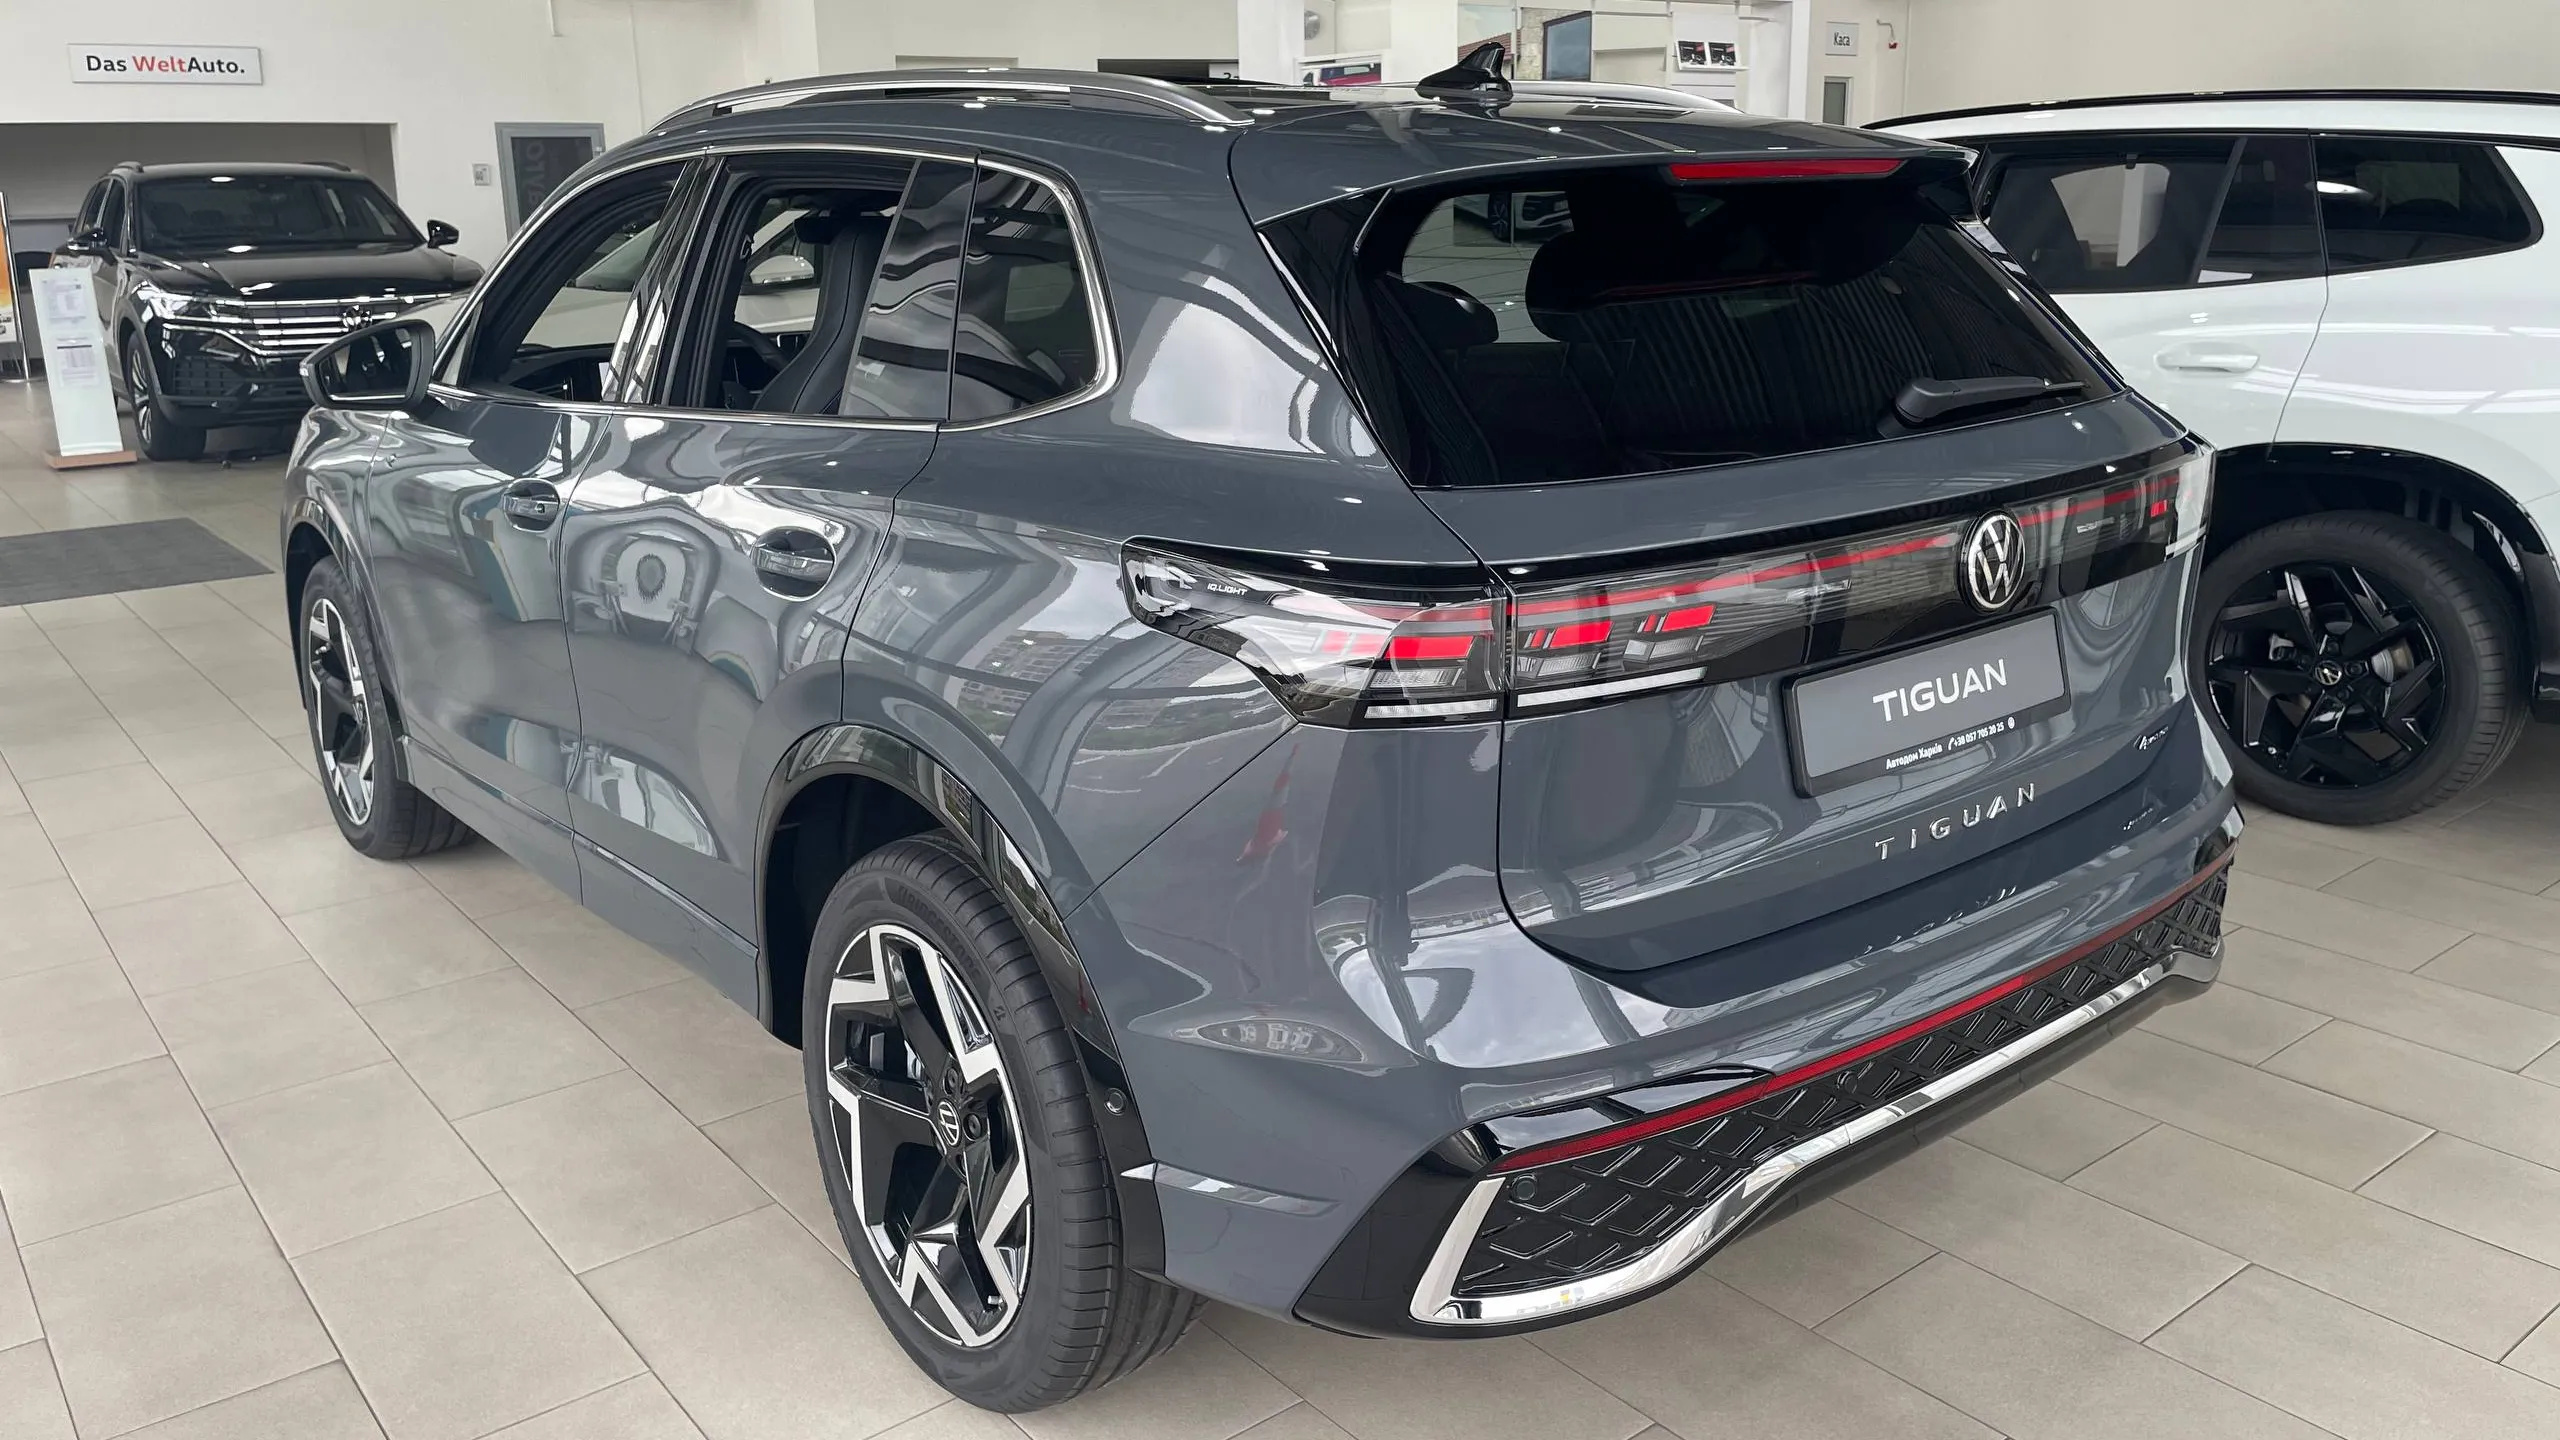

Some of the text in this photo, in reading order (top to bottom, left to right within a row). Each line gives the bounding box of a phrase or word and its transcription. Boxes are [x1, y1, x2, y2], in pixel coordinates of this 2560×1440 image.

[1833, 32, 1851, 47] Каса
[86, 55, 245, 74] Das WeltAuto.
[1207, 583, 1248, 596] IQ.LIGHT
[1872, 658, 2007, 722] TIGUAN
[1886, 752, 1919, 770] Автодом
[1918, 742, 1943, 759] Харків
[1874, 782, 2035, 860] TIGUAN
